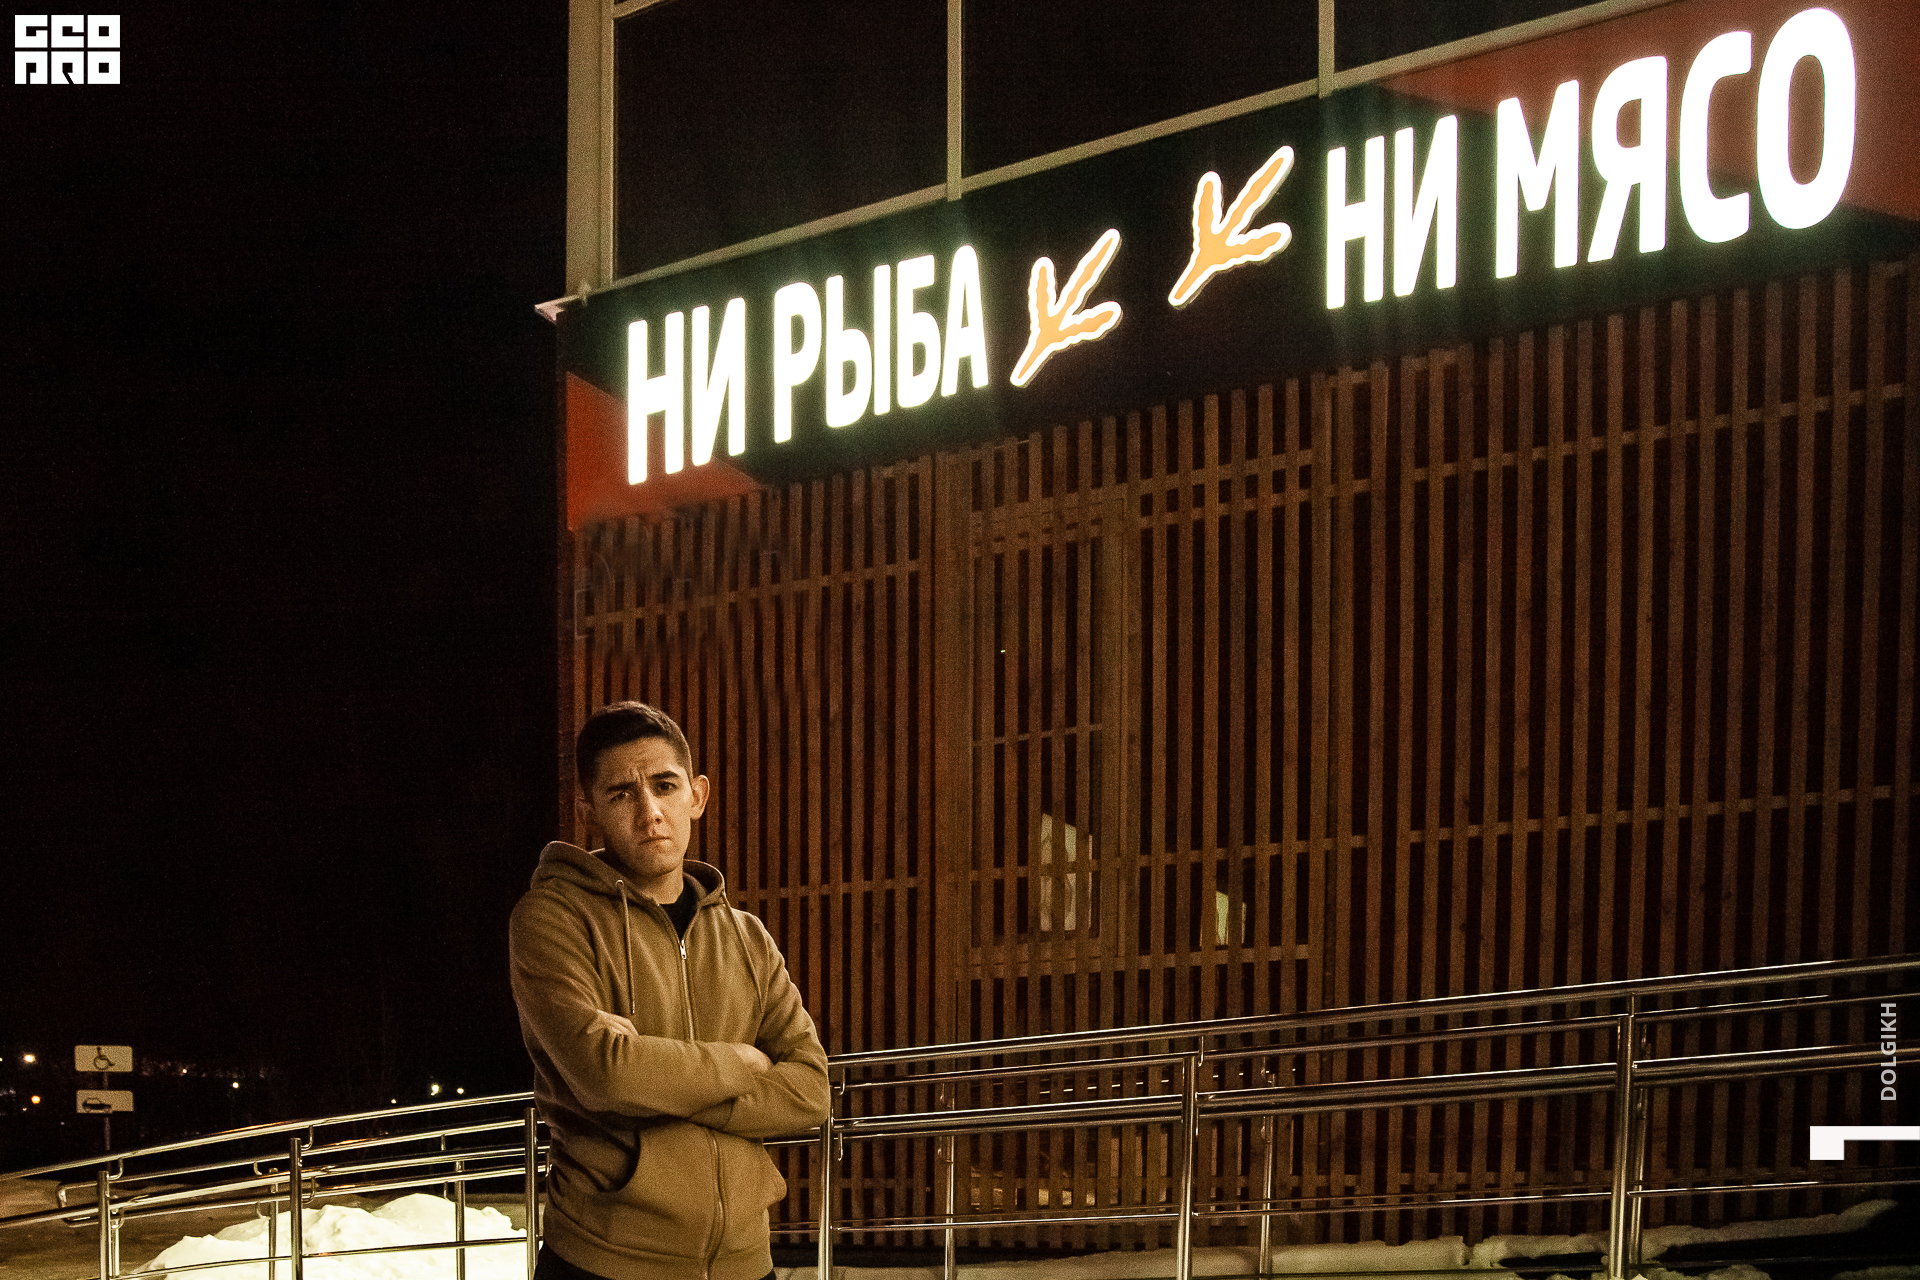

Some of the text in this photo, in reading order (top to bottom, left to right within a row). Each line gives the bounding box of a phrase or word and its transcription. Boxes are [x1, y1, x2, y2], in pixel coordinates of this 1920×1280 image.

[628, 8, 1855, 485] НИ РЫБА НИ МЯСО
